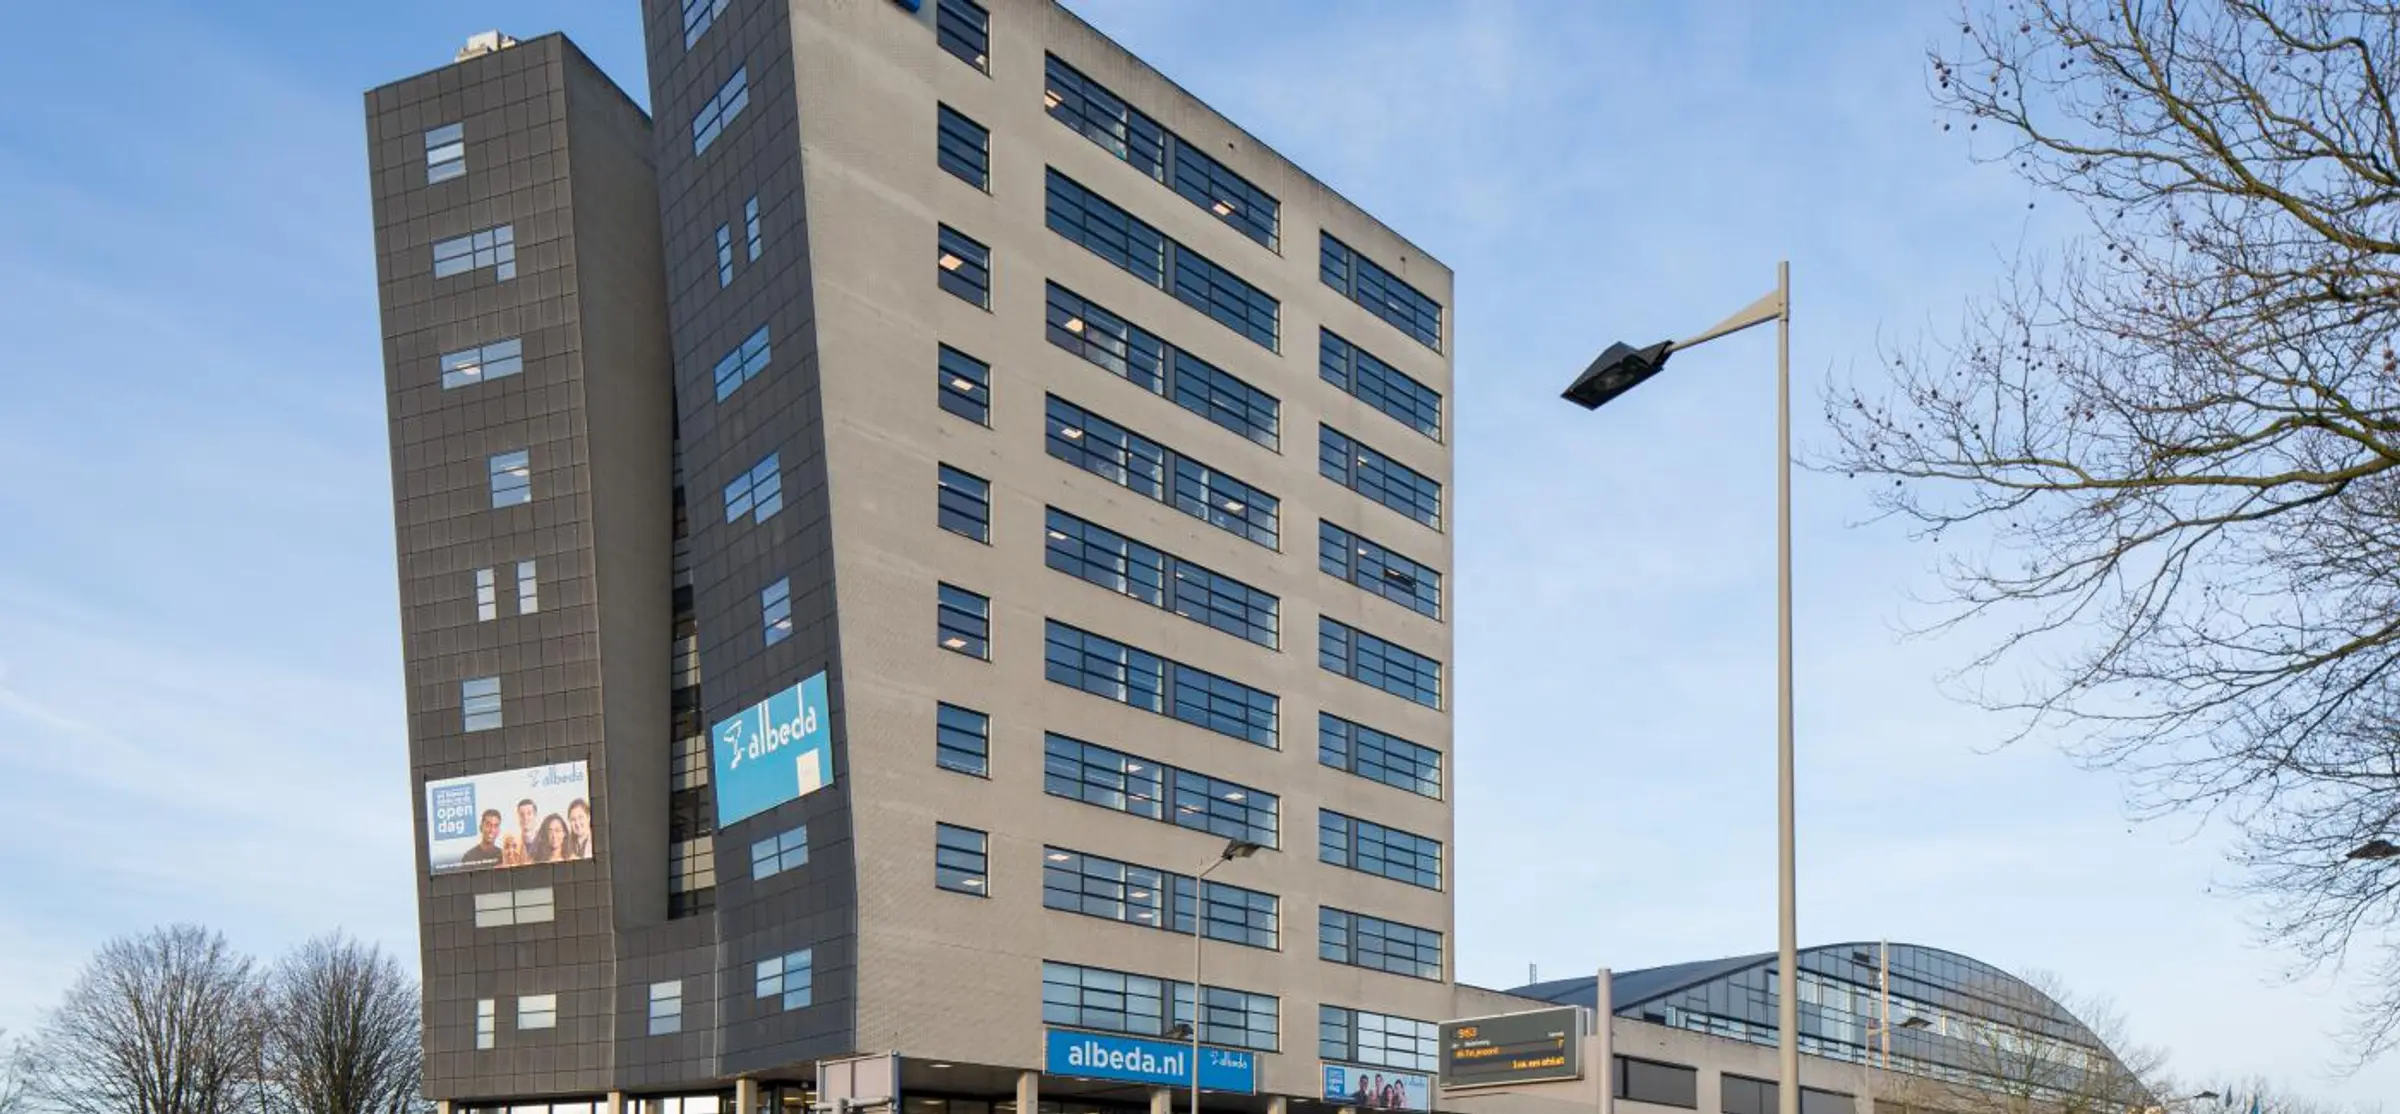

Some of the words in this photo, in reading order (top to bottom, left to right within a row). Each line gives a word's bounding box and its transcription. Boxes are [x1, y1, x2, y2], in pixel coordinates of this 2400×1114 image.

[749, 682, 817, 759] albeda
[437, 805, 473, 820] open
[439, 820, 465, 835] dag
[1068, 1041, 1185, 1076] albeda.nl
